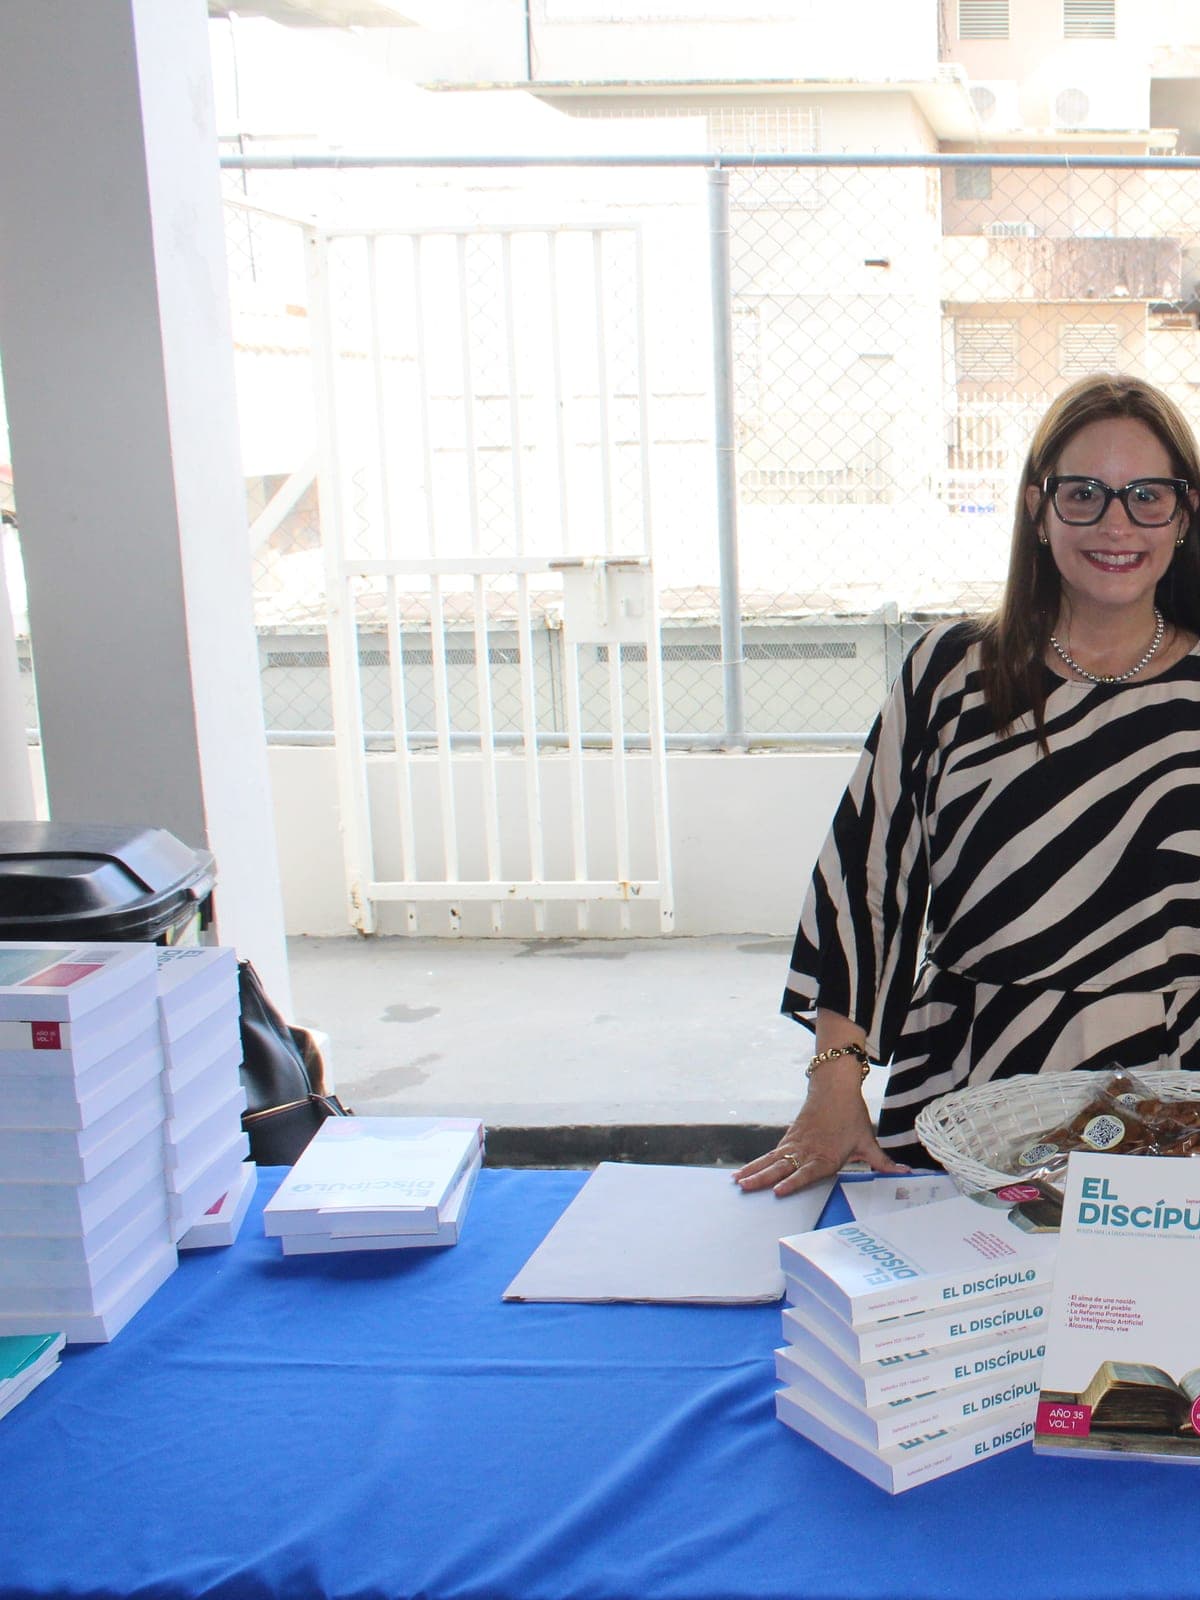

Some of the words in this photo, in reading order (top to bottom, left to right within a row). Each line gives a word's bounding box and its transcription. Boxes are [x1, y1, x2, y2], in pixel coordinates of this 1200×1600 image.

[1081, 1177, 1118, 1201] EL
[863, 1267, 890, 1286] EL
[942, 1286, 959, 1300] EL
[962, 1269, 1036, 1295] DISCÍPULO
[950, 1323, 967, 1337] EL
[970, 1305, 1044, 1331] DISCÍPULO
[1081, 1316, 1117, 1325] Inteligencia
[1105, 1311, 1141, 1319] Protestante
[954, 1365, 972, 1379] EL
[962, 1401, 979, 1415] EL
[981, 1381, 1041, 1409] DISCÍPUL
[1049, 1408, 1071, 1419] AÑO
[1073, 1411, 1084, 1419] 35
[974, 1442, 990, 1456] EL
[992, 1422, 1036, 1448] DISCÍP
